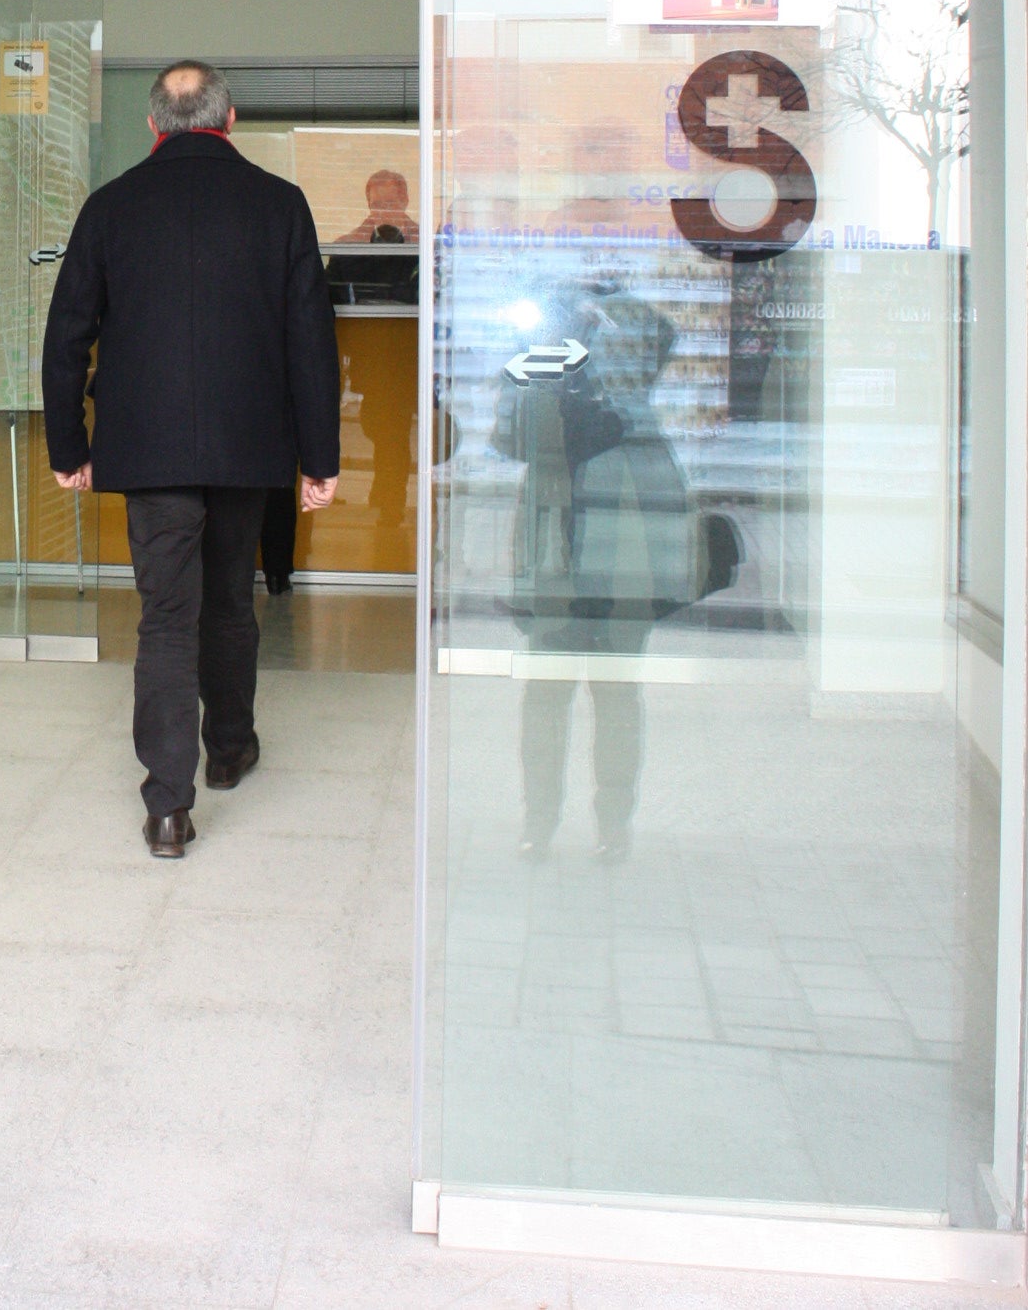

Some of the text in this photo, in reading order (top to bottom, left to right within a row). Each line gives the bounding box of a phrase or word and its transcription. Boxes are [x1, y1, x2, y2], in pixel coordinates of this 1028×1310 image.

[443, 223, 539, 249] Servicio
[555, 223, 580, 248] de
[592, 223, 658, 249] Salud
